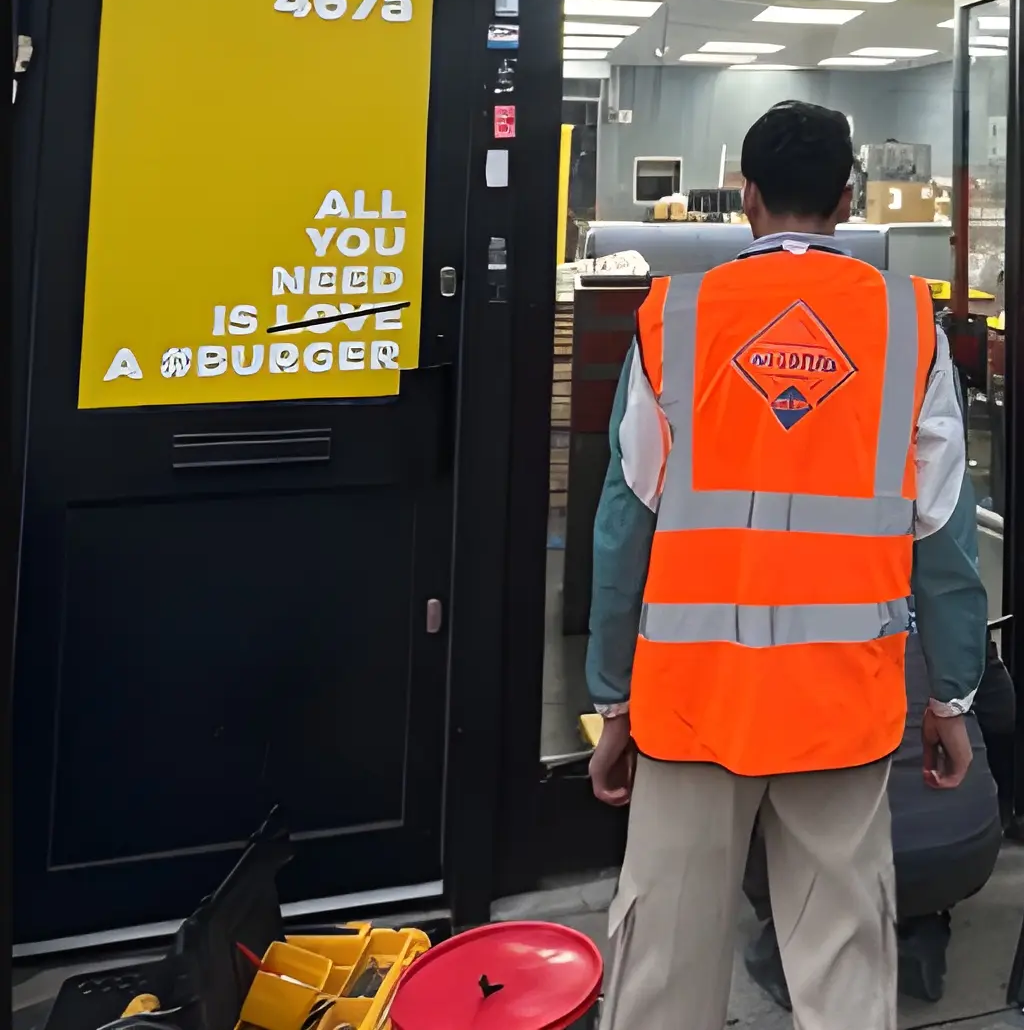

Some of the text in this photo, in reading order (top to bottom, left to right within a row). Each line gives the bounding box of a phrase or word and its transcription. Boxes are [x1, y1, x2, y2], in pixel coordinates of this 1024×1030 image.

[314, 189, 407, 220] ALL
[305, 226, 406, 257] YOU
[272, 265, 403, 295] NEED
[212, 301, 408, 336] IS LOVE
[103, 347, 144, 382] A
